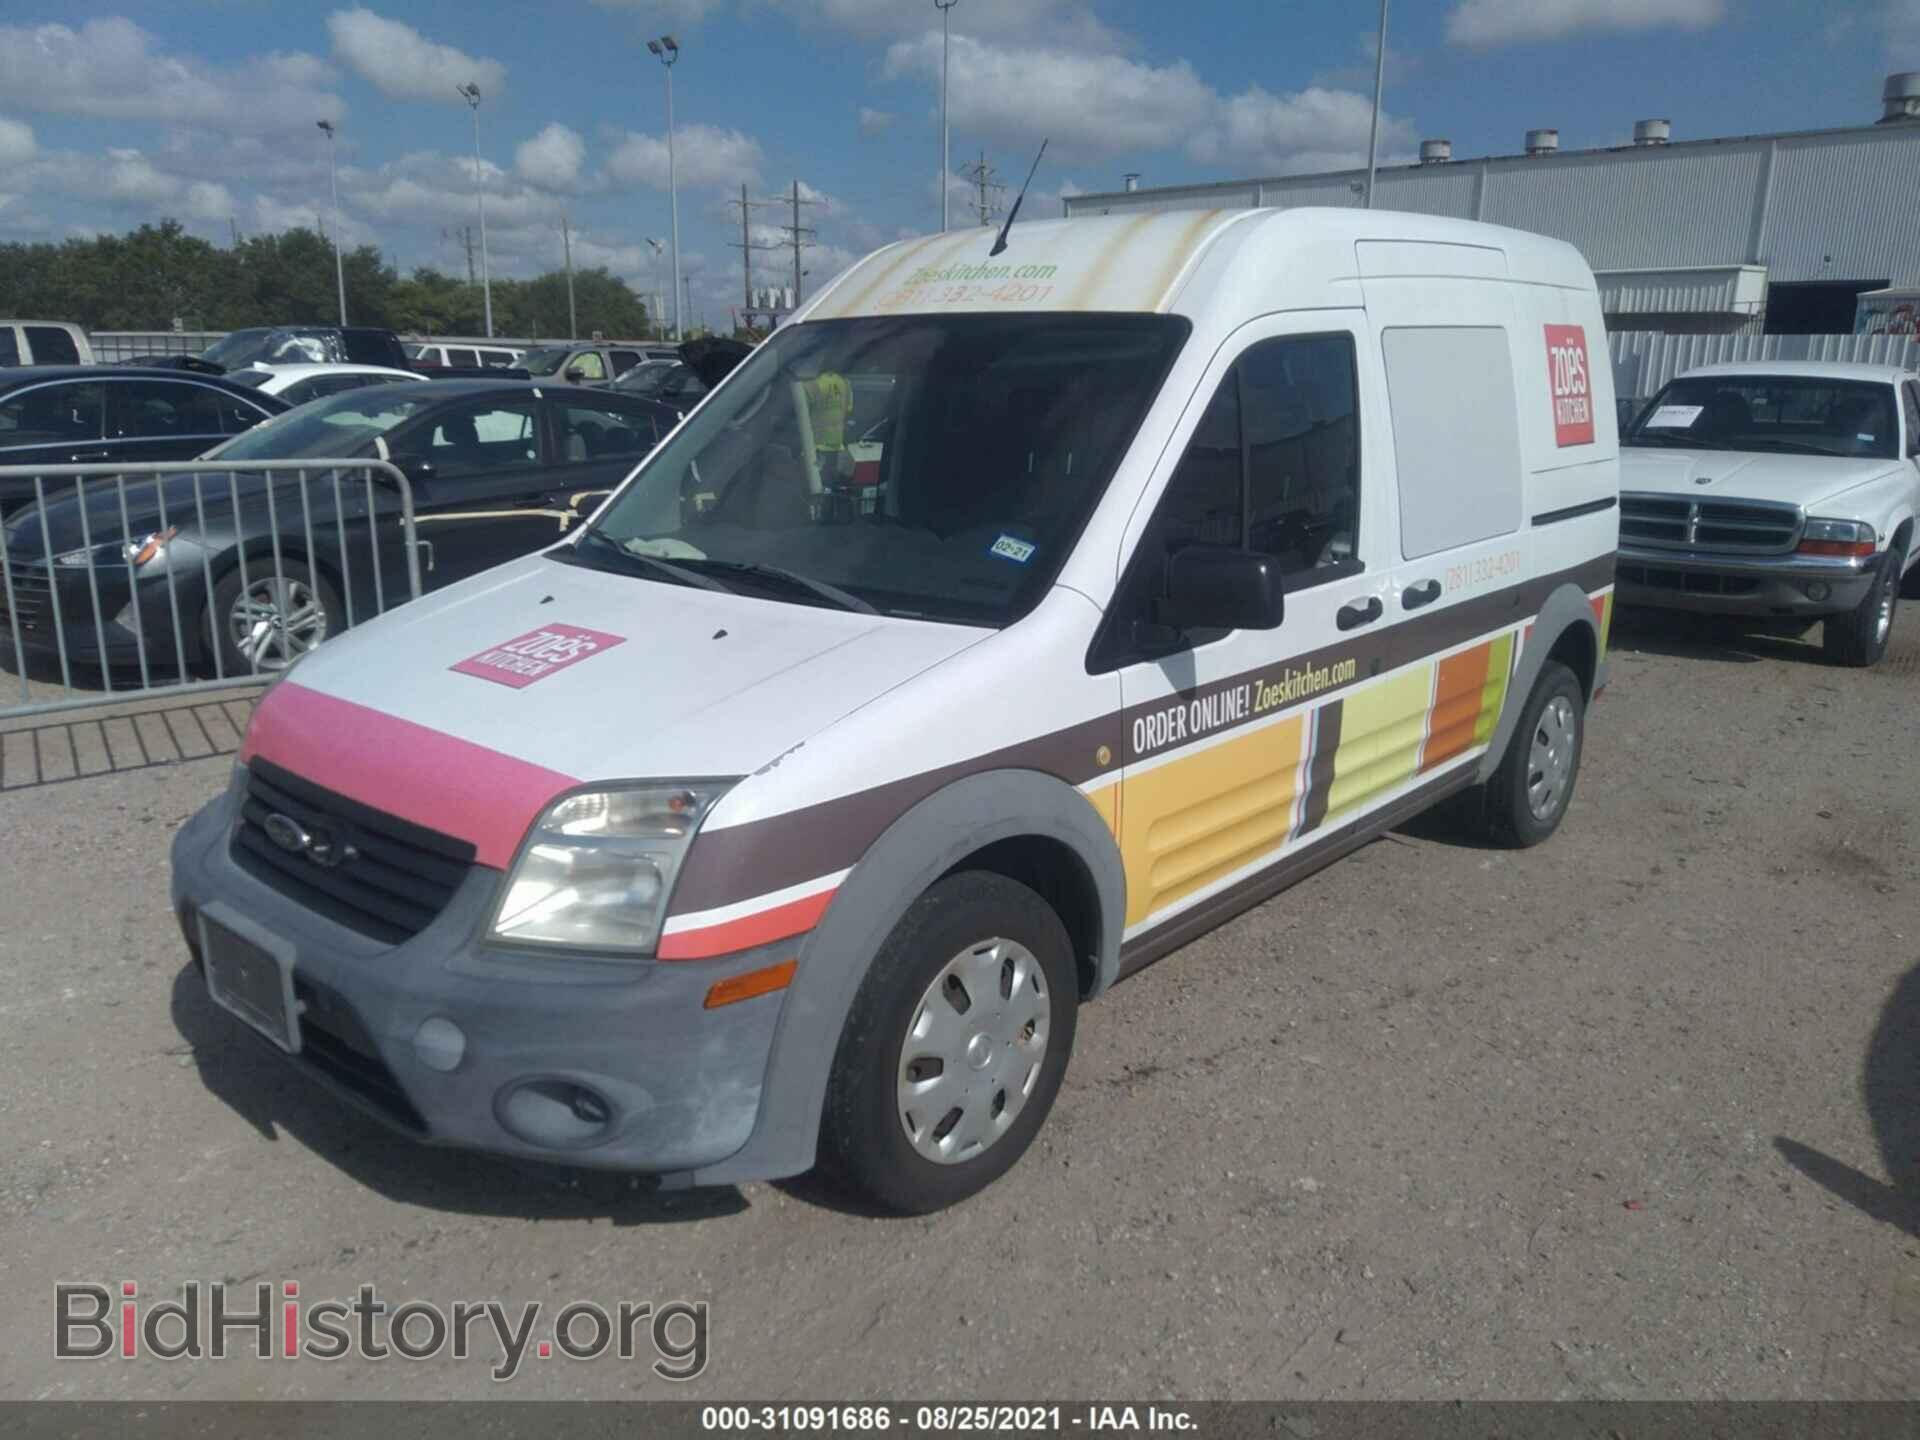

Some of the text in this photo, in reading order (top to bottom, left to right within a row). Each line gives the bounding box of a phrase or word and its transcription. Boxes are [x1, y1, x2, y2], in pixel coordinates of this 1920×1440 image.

[1132, 657, 1357, 755] ORDER ONLINE! Zoeskitchen.com
